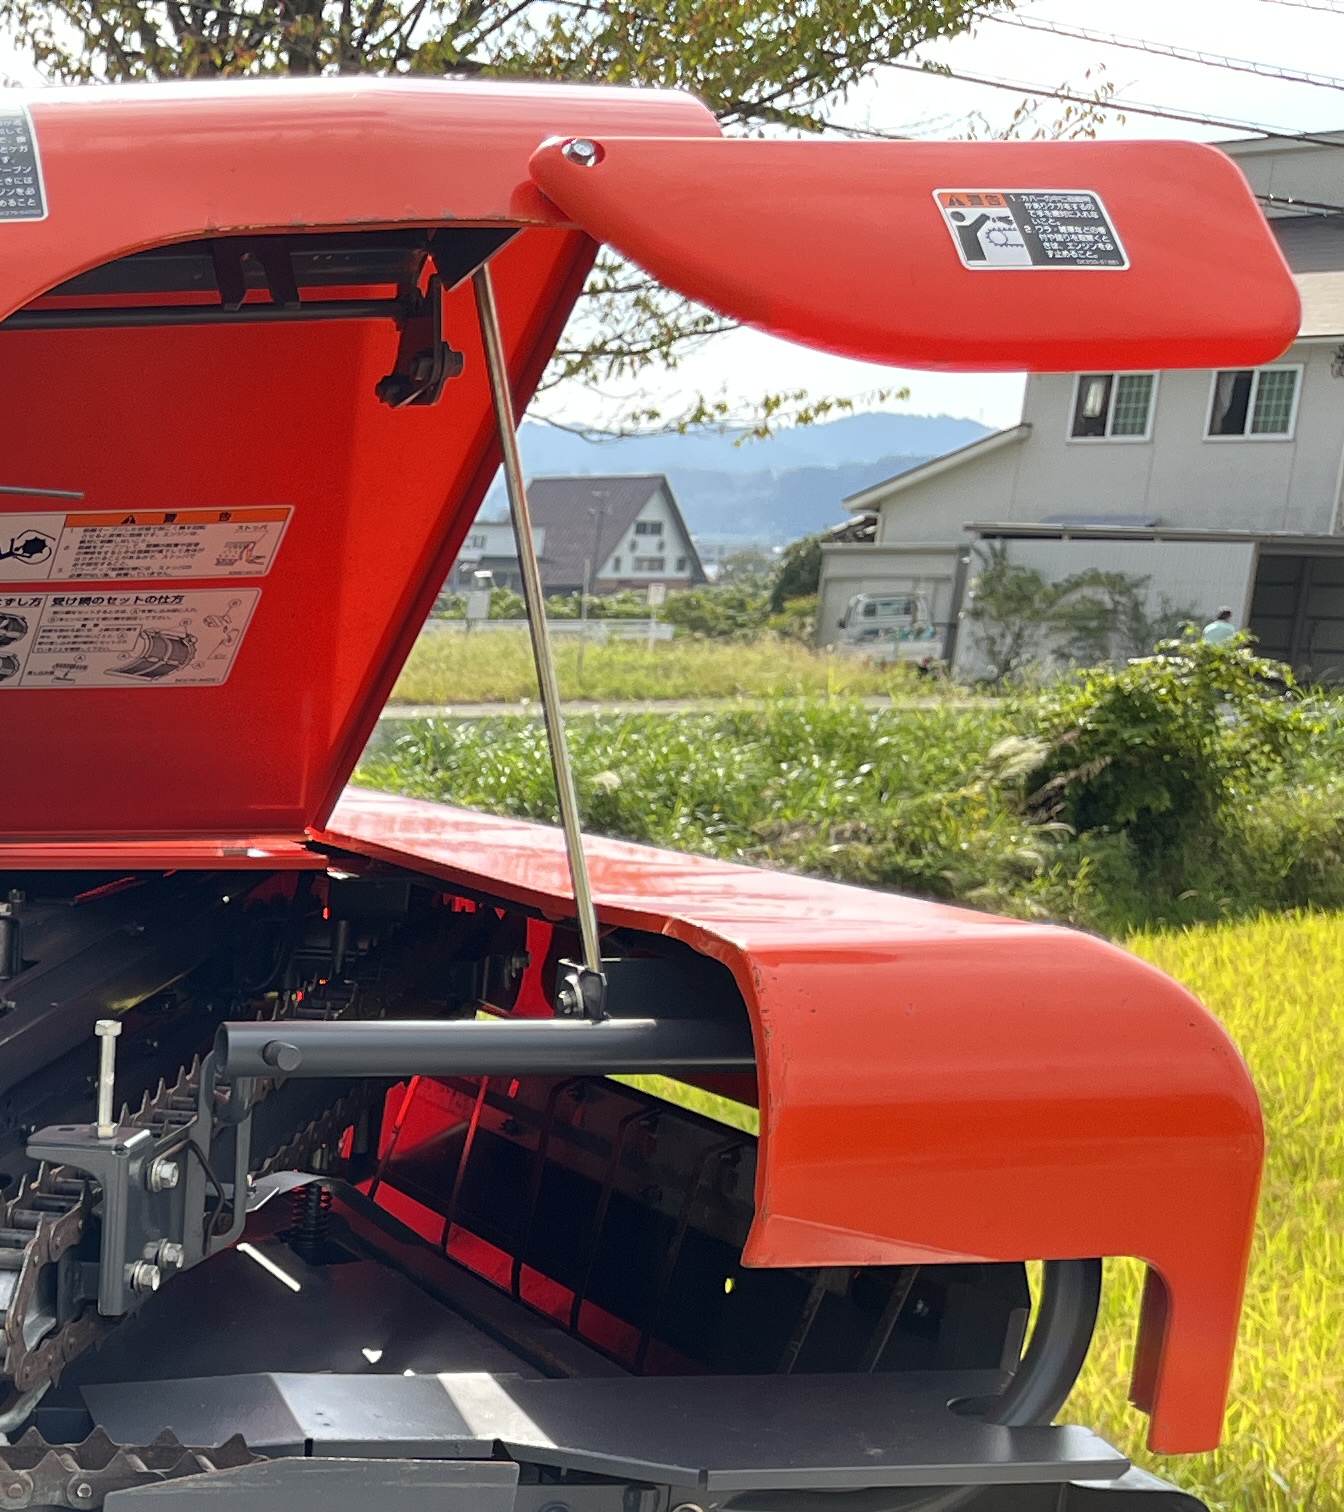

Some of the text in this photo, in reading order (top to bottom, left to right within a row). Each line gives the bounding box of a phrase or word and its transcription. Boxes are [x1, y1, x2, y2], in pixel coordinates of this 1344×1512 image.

[50, 594, 185, 606] 受け網のセットの仕方
